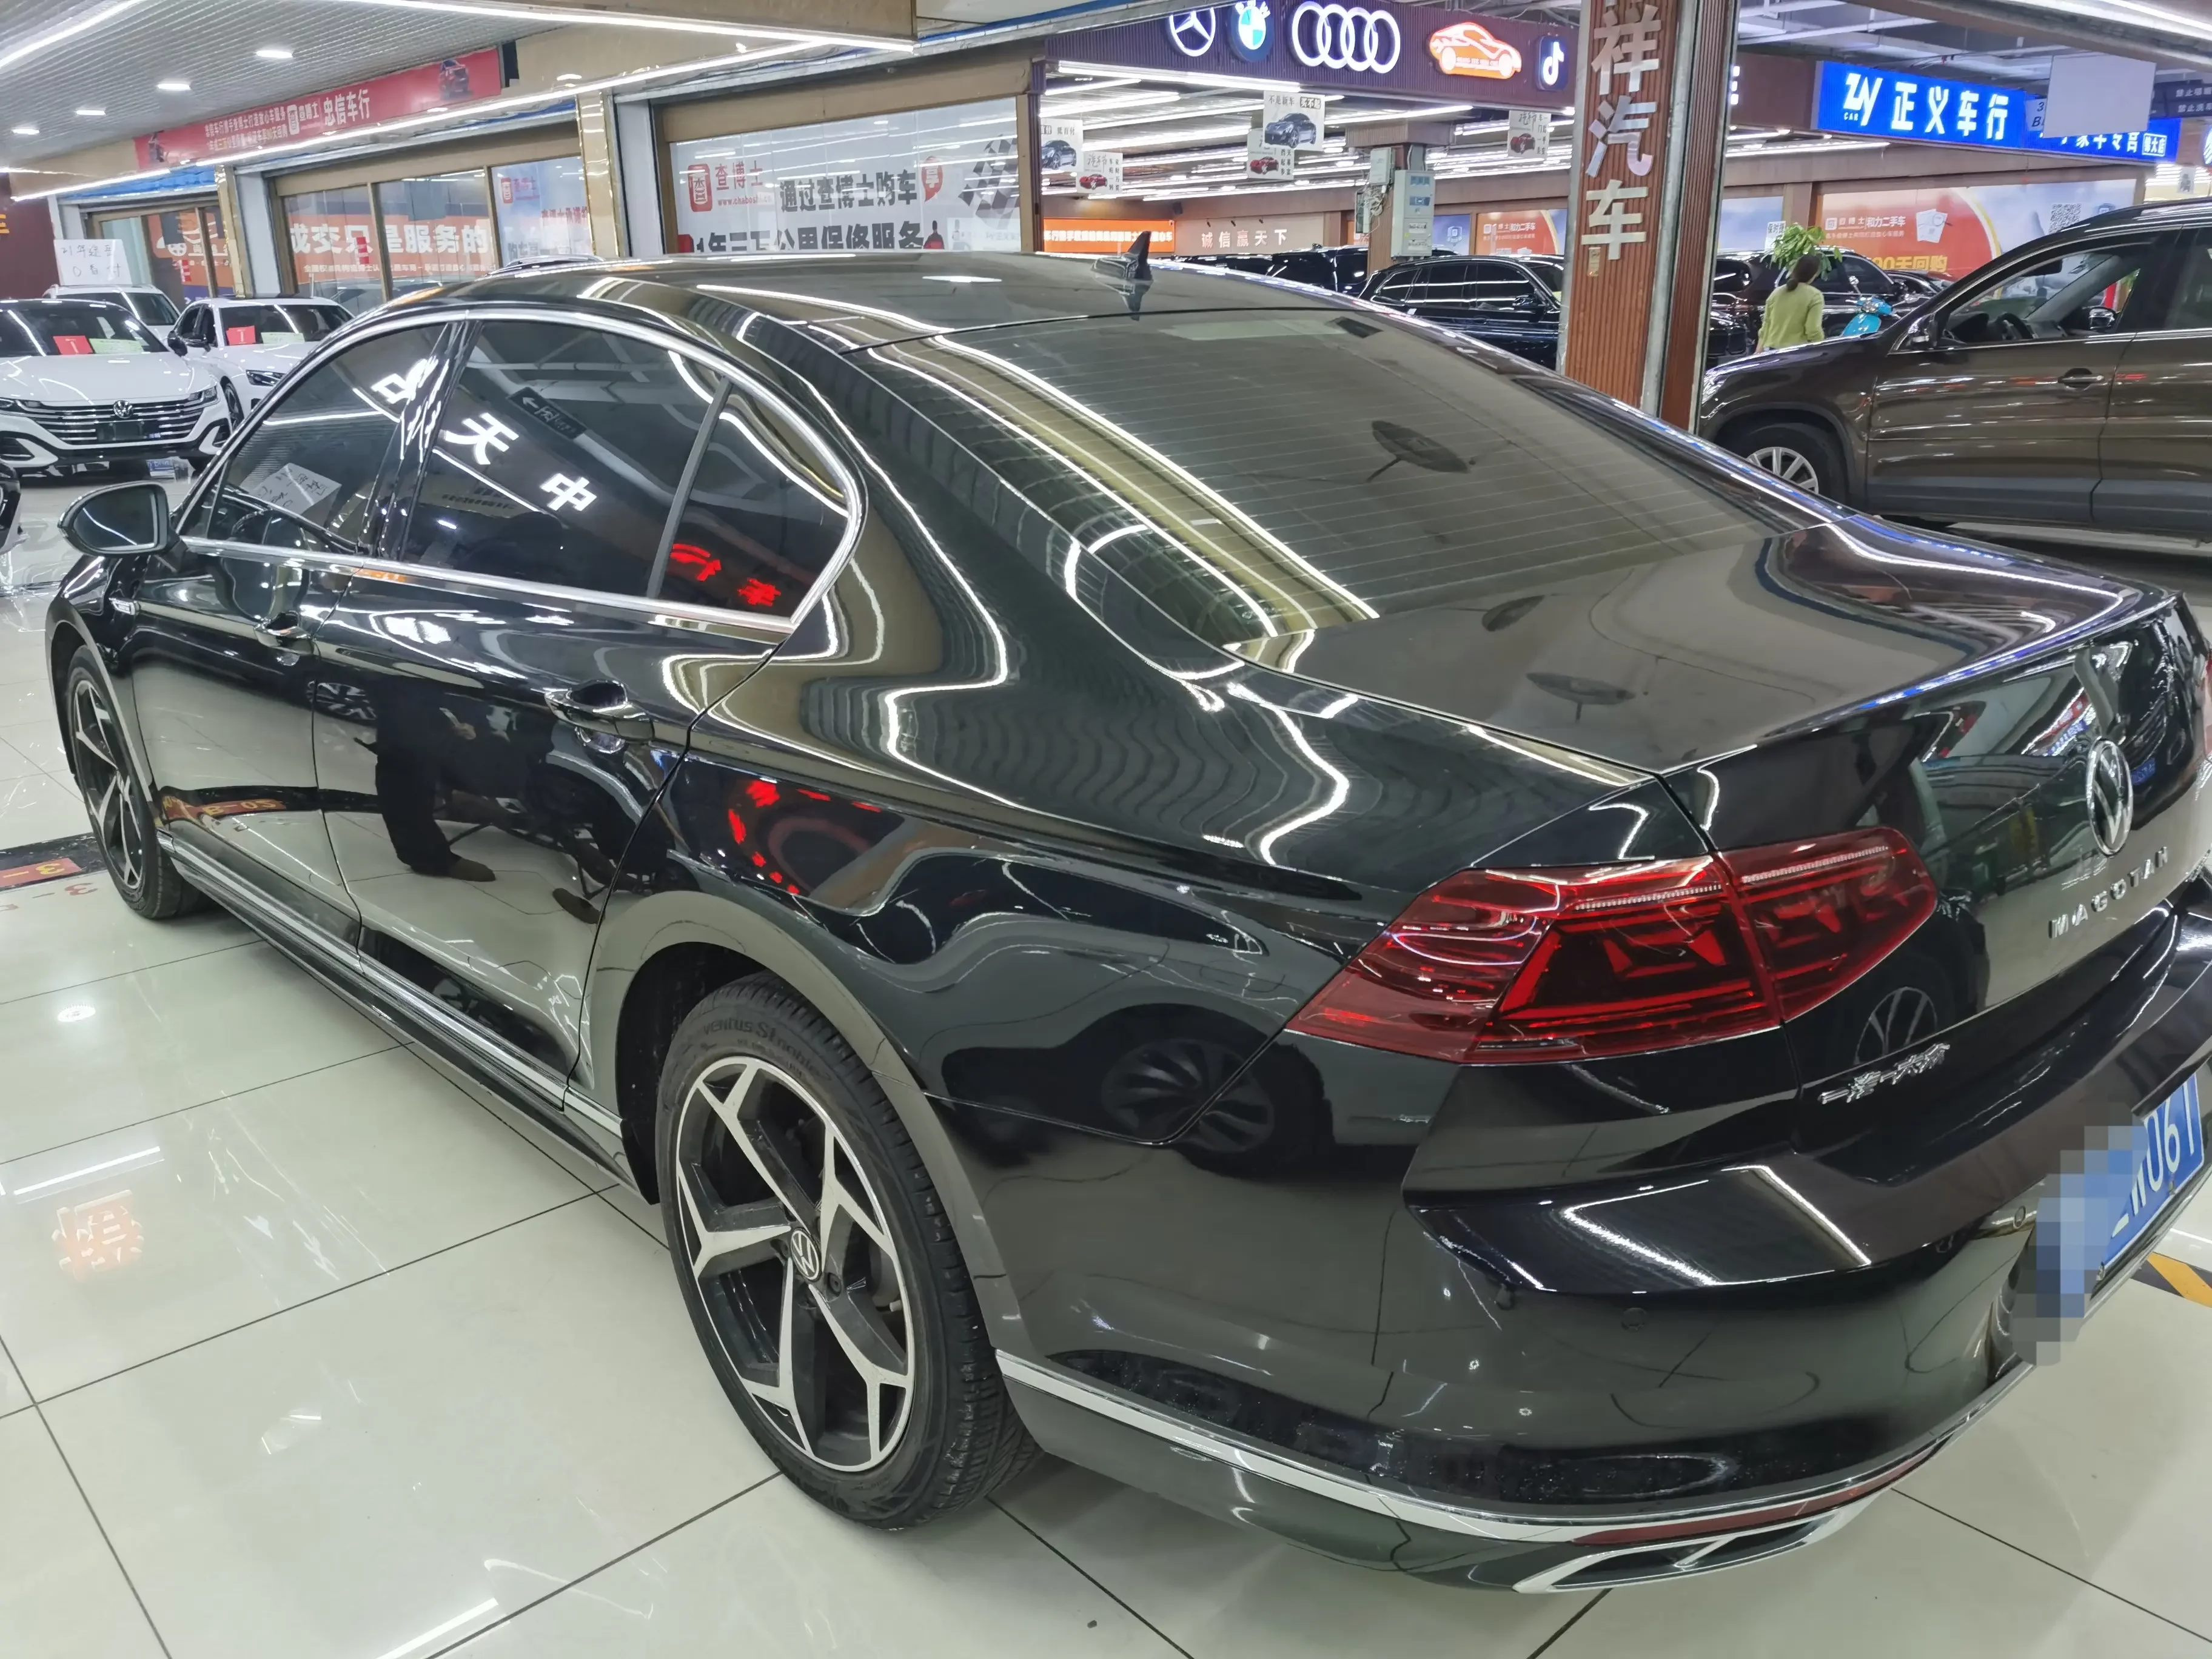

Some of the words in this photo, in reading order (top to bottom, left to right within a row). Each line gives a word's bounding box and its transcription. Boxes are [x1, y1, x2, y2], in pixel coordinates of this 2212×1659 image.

[323, 89, 370, 127] 忠信车行
[1844, 112, 1858, 121] CAR
[1891, 81, 2009, 140] 正义车行
[1581, 0, 1661, 260] 祥汽车
[715, 160, 763, 190] 查博士
[780, 169, 917, 213] 通过查博士购车
[1201, 229, 1287, 249] 诚信赢天下
[2048, 846, 2168, 939] MAGOTAN
